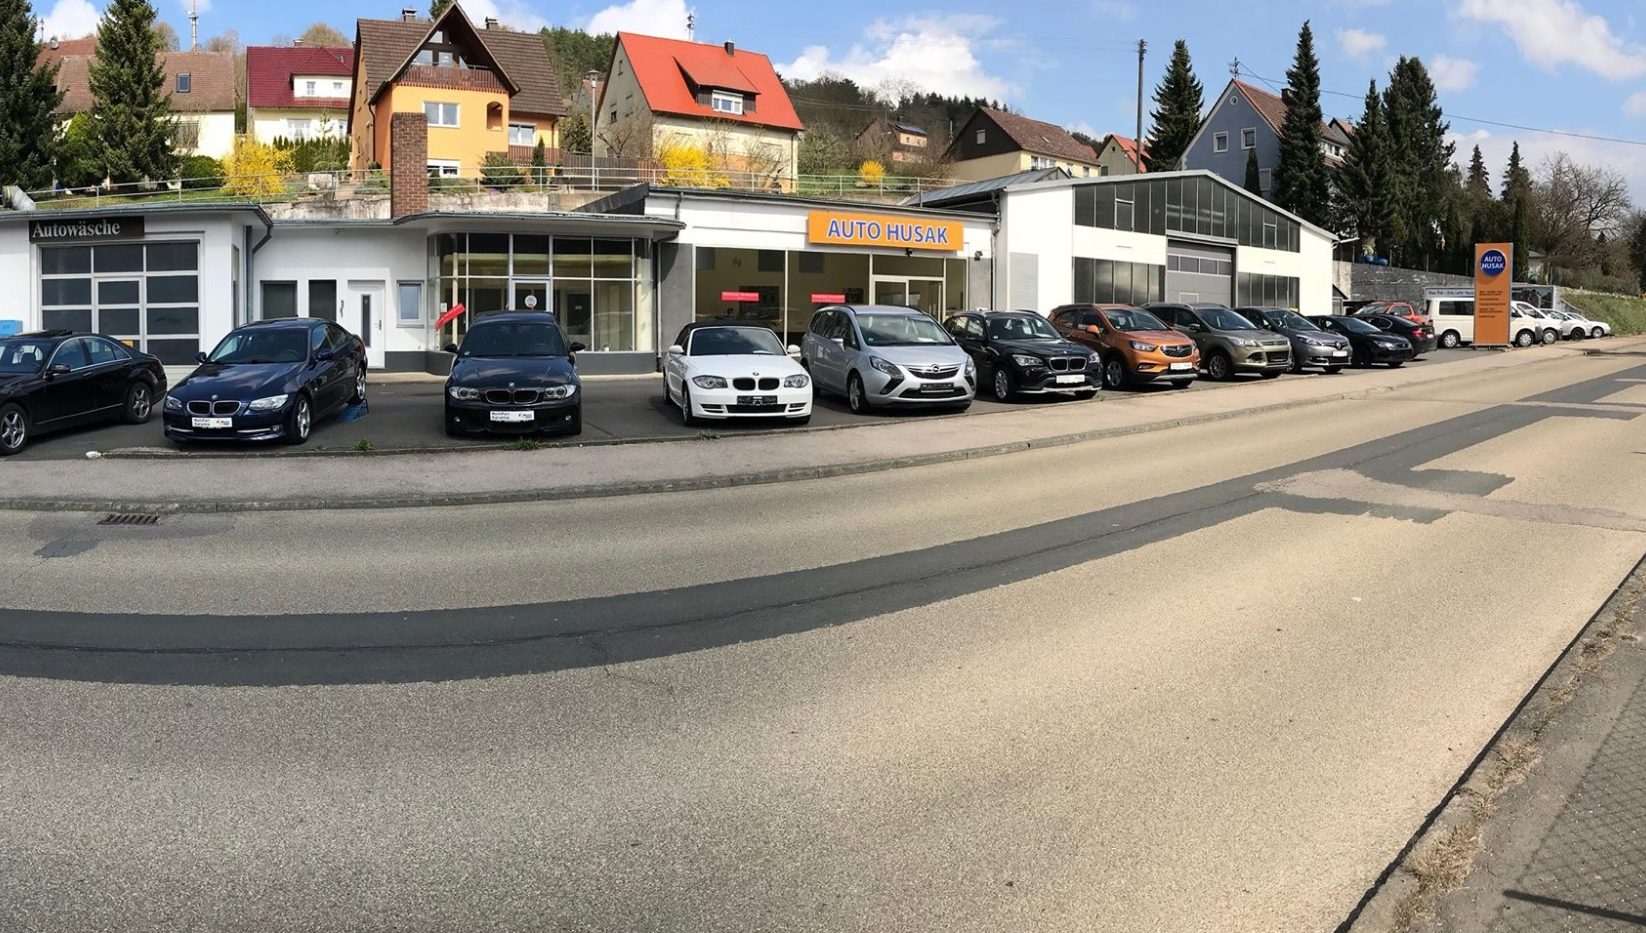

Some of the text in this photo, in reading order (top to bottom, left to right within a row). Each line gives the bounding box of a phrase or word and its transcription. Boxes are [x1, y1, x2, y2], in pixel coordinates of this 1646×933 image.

[32, 219, 121, 238] Autowäsche
[827, 218, 949, 245] AUTO HUSAK
